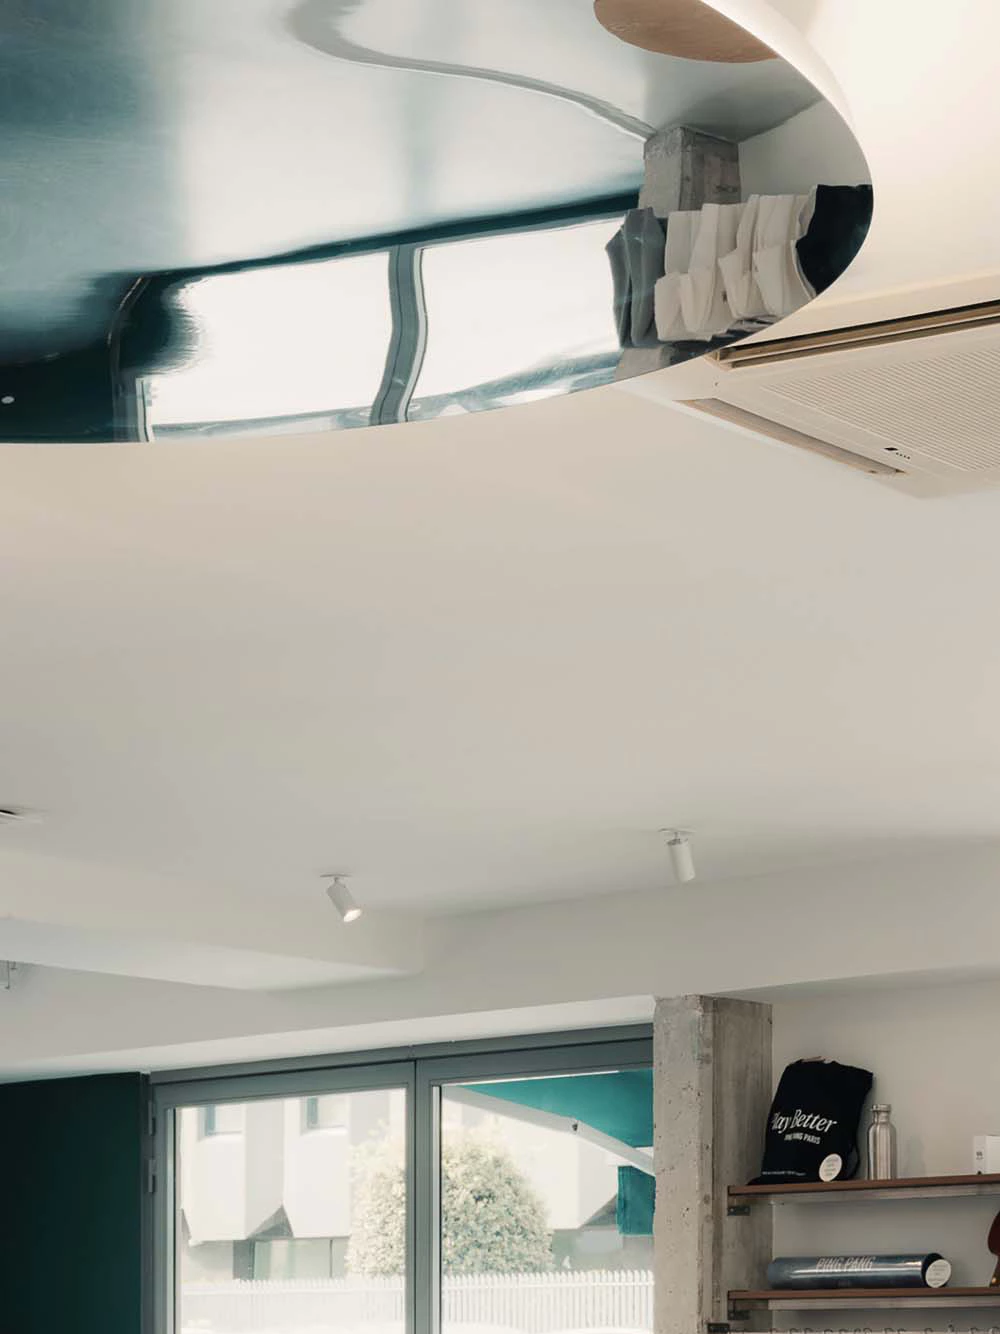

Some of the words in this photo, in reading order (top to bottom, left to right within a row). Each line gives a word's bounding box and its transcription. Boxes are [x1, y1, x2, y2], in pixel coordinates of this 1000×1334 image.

[790, 1109, 837, 1132] Better
[803, 1133, 821, 1145] PARIS
[816, 1256, 842, 1273] PING
[845, 1255, 876, 1272] PANG
